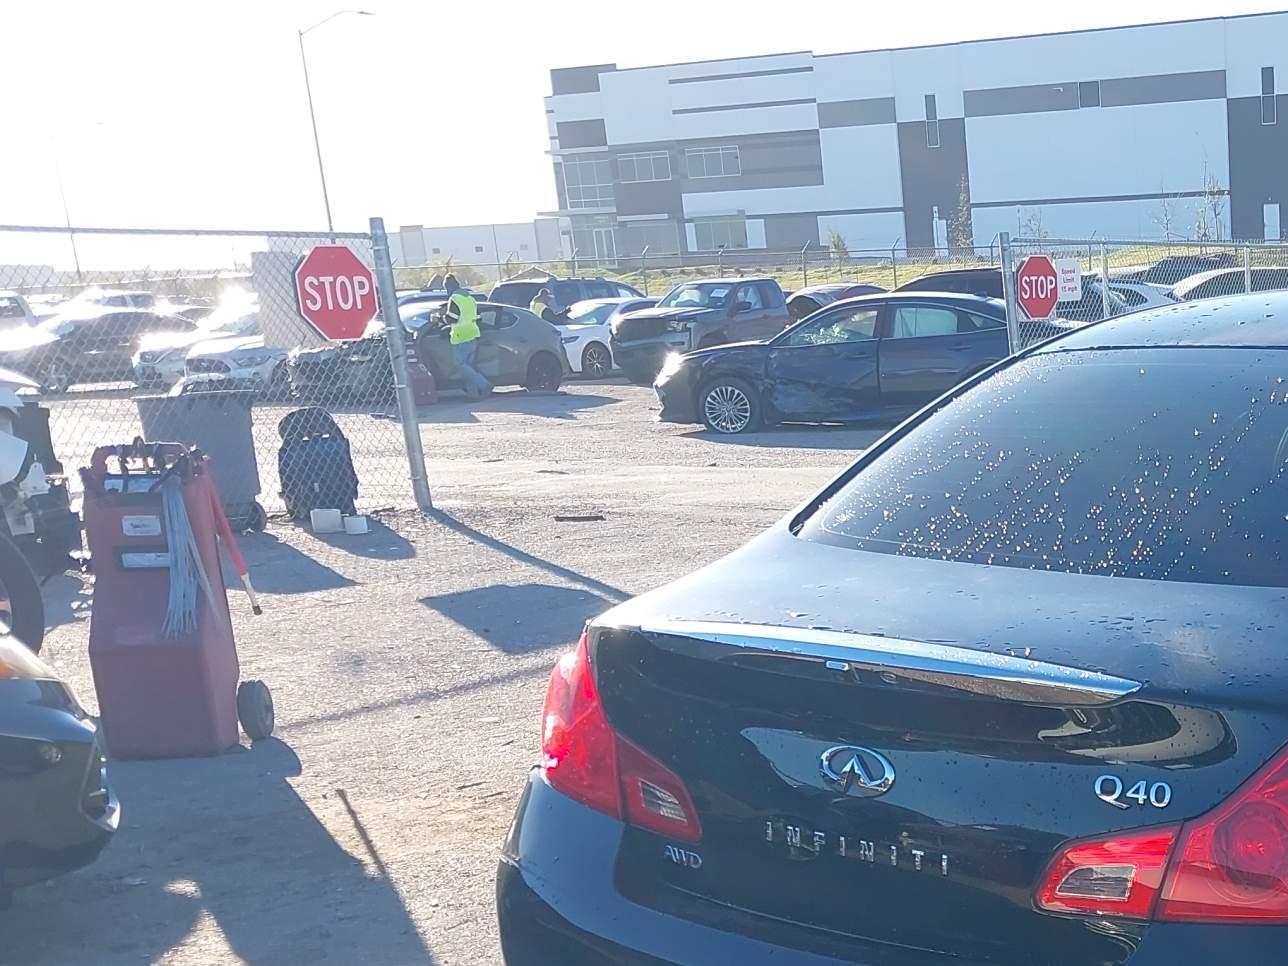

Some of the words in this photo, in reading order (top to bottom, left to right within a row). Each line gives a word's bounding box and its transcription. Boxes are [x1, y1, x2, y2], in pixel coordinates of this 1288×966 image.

[304, 275, 370, 311] STOP
[1021, 275, 1056, 299] STOP
[1094, 775, 1172, 810] Q40
[664, 844, 703, 869] AWD
[765, 821, 948, 876] INFINITI
